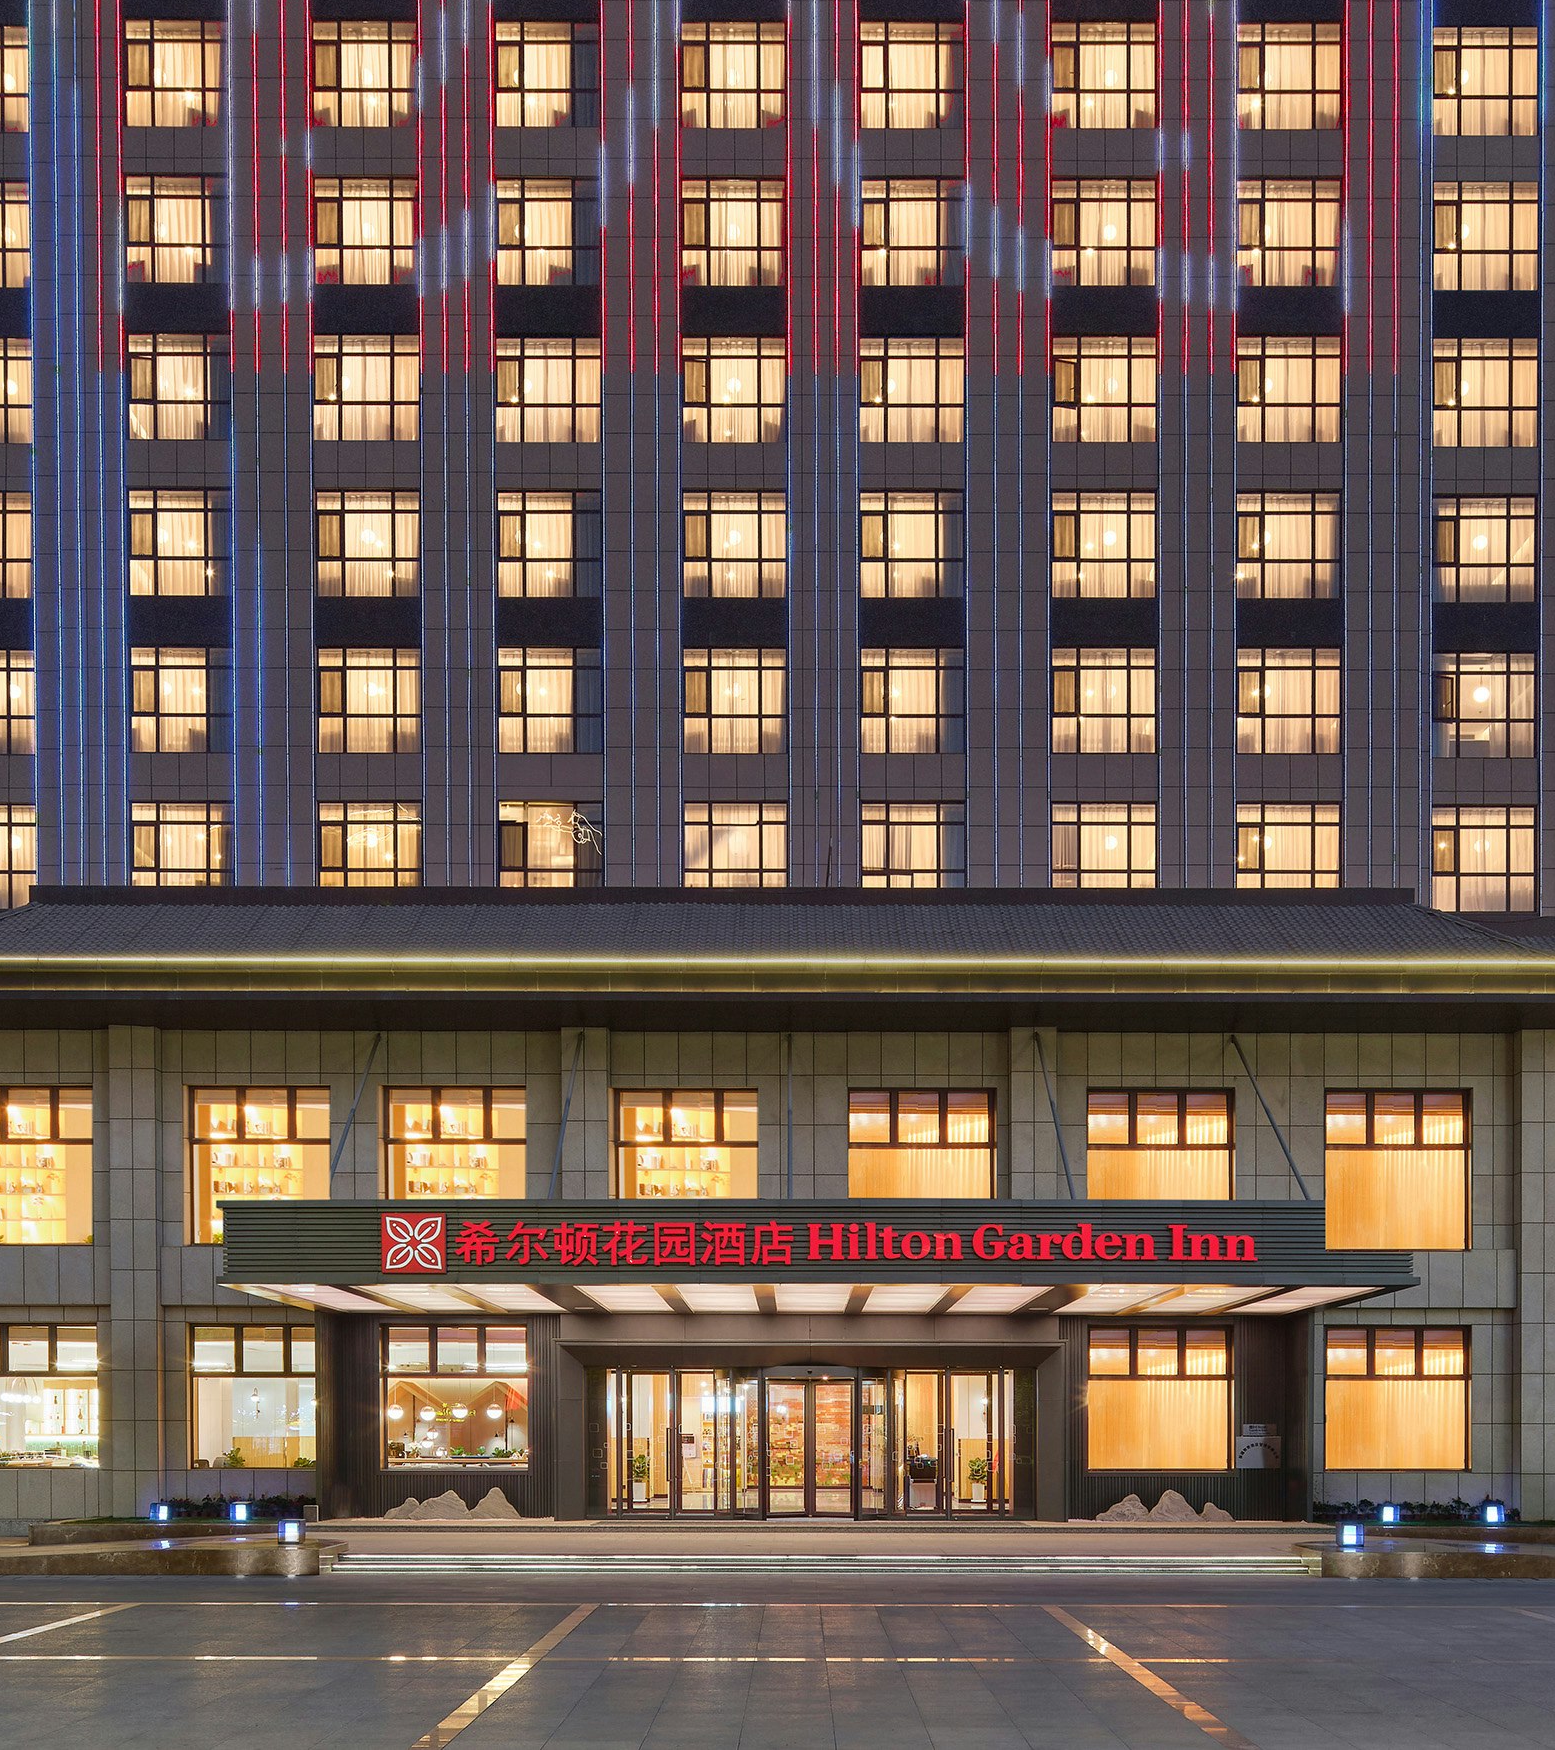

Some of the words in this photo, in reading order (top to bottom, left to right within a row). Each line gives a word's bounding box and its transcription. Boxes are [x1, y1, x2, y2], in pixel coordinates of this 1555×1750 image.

[454, 1220, 795, 1266] 希尔顿花园酒店
[807, 1222, 964, 1260] Hilton
[972, 1223, 1158, 1260] Garden
[1167, 1224, 1258, 1261] Inn
